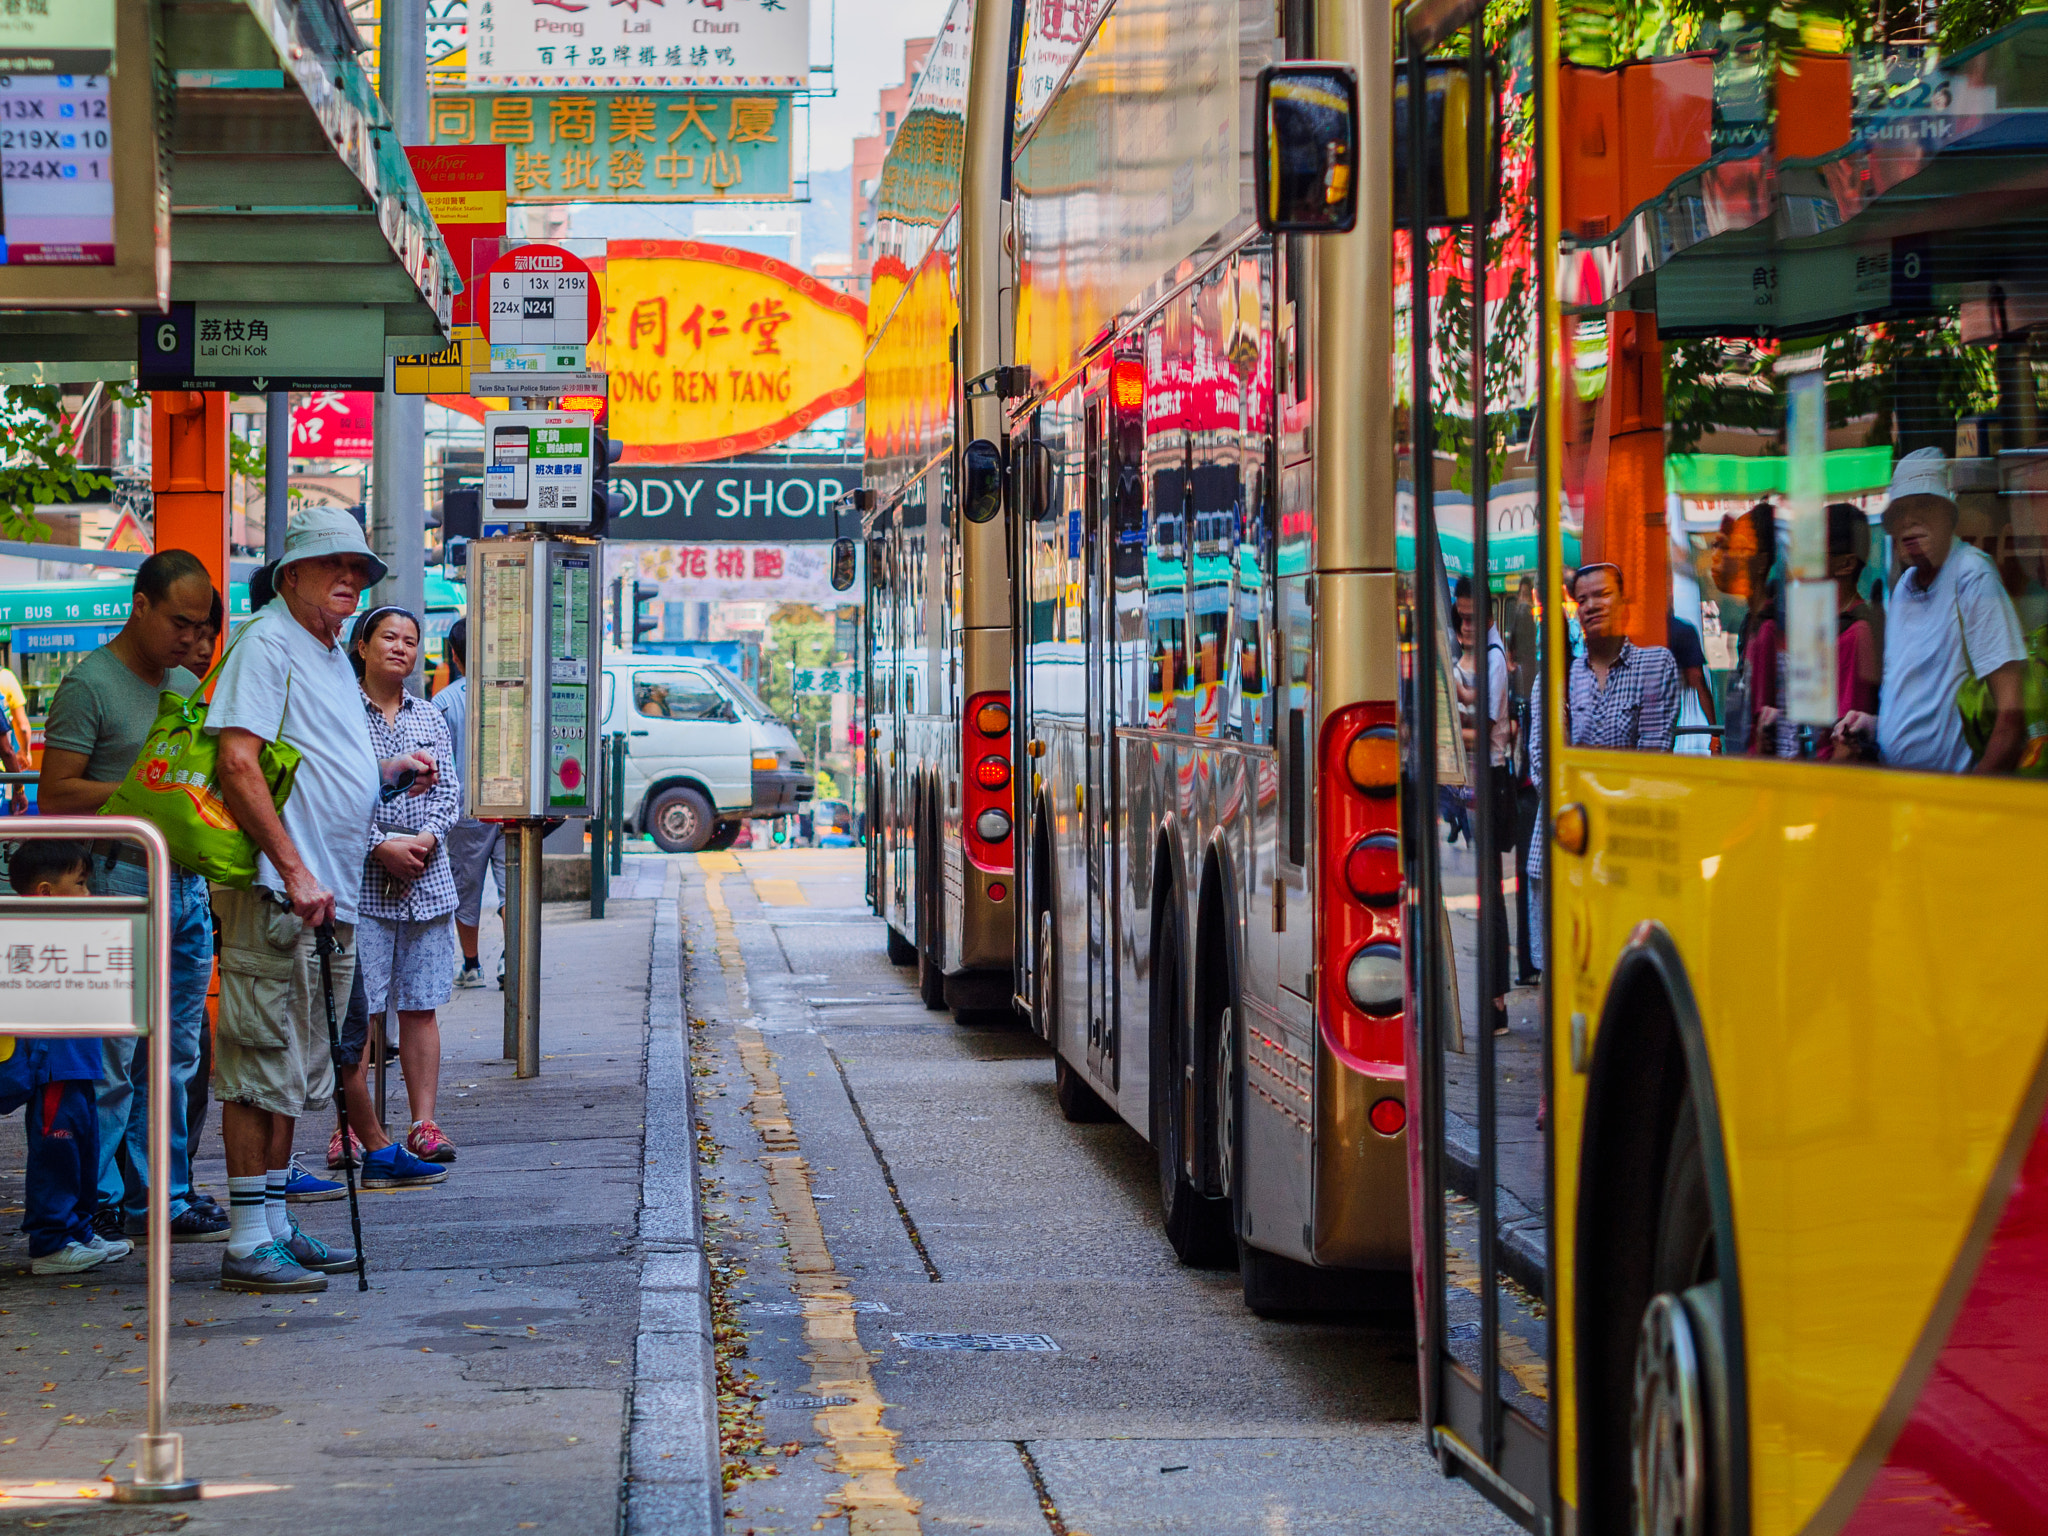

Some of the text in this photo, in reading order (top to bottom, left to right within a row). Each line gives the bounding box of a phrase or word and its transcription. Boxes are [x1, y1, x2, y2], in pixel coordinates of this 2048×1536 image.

[535, 18, 740, 37] Peng Lai Chun
[2, 99, 107, 119] 13X 12
[2, 130, 108, 149] 219X 10
[4, 160, 100, 179] 224X 1
[528, 255, 564, 271] KMB
[503, 277, 586, 290] 6 13x 219x
[492, 301, 554, 314] 224x N241
[157, 323, 177, 352] 6
[200, 319, 269, 342] 荔枝角
[200, 345, 268, 357] Lai Chi Kok
[563, 357, 570, 366] 6
[478, 384, 493, 392] Tsim
[494, 384, 505, 392] Sha
[506, 384, 519, 392] Tsui
[520, 384, 538, 392] Police
[539, 384, 560, 392] Station
[606, 370, 791, 402] ONG REN TANG
[608, 478, 843, 518] ODY SHOP
[24, 605, 53, 619] BUS
[64, 604, 80, 617] 16
[93, 602, 132, 616] SEAT
[0, 978, 136, 990] eds board the bus firs
